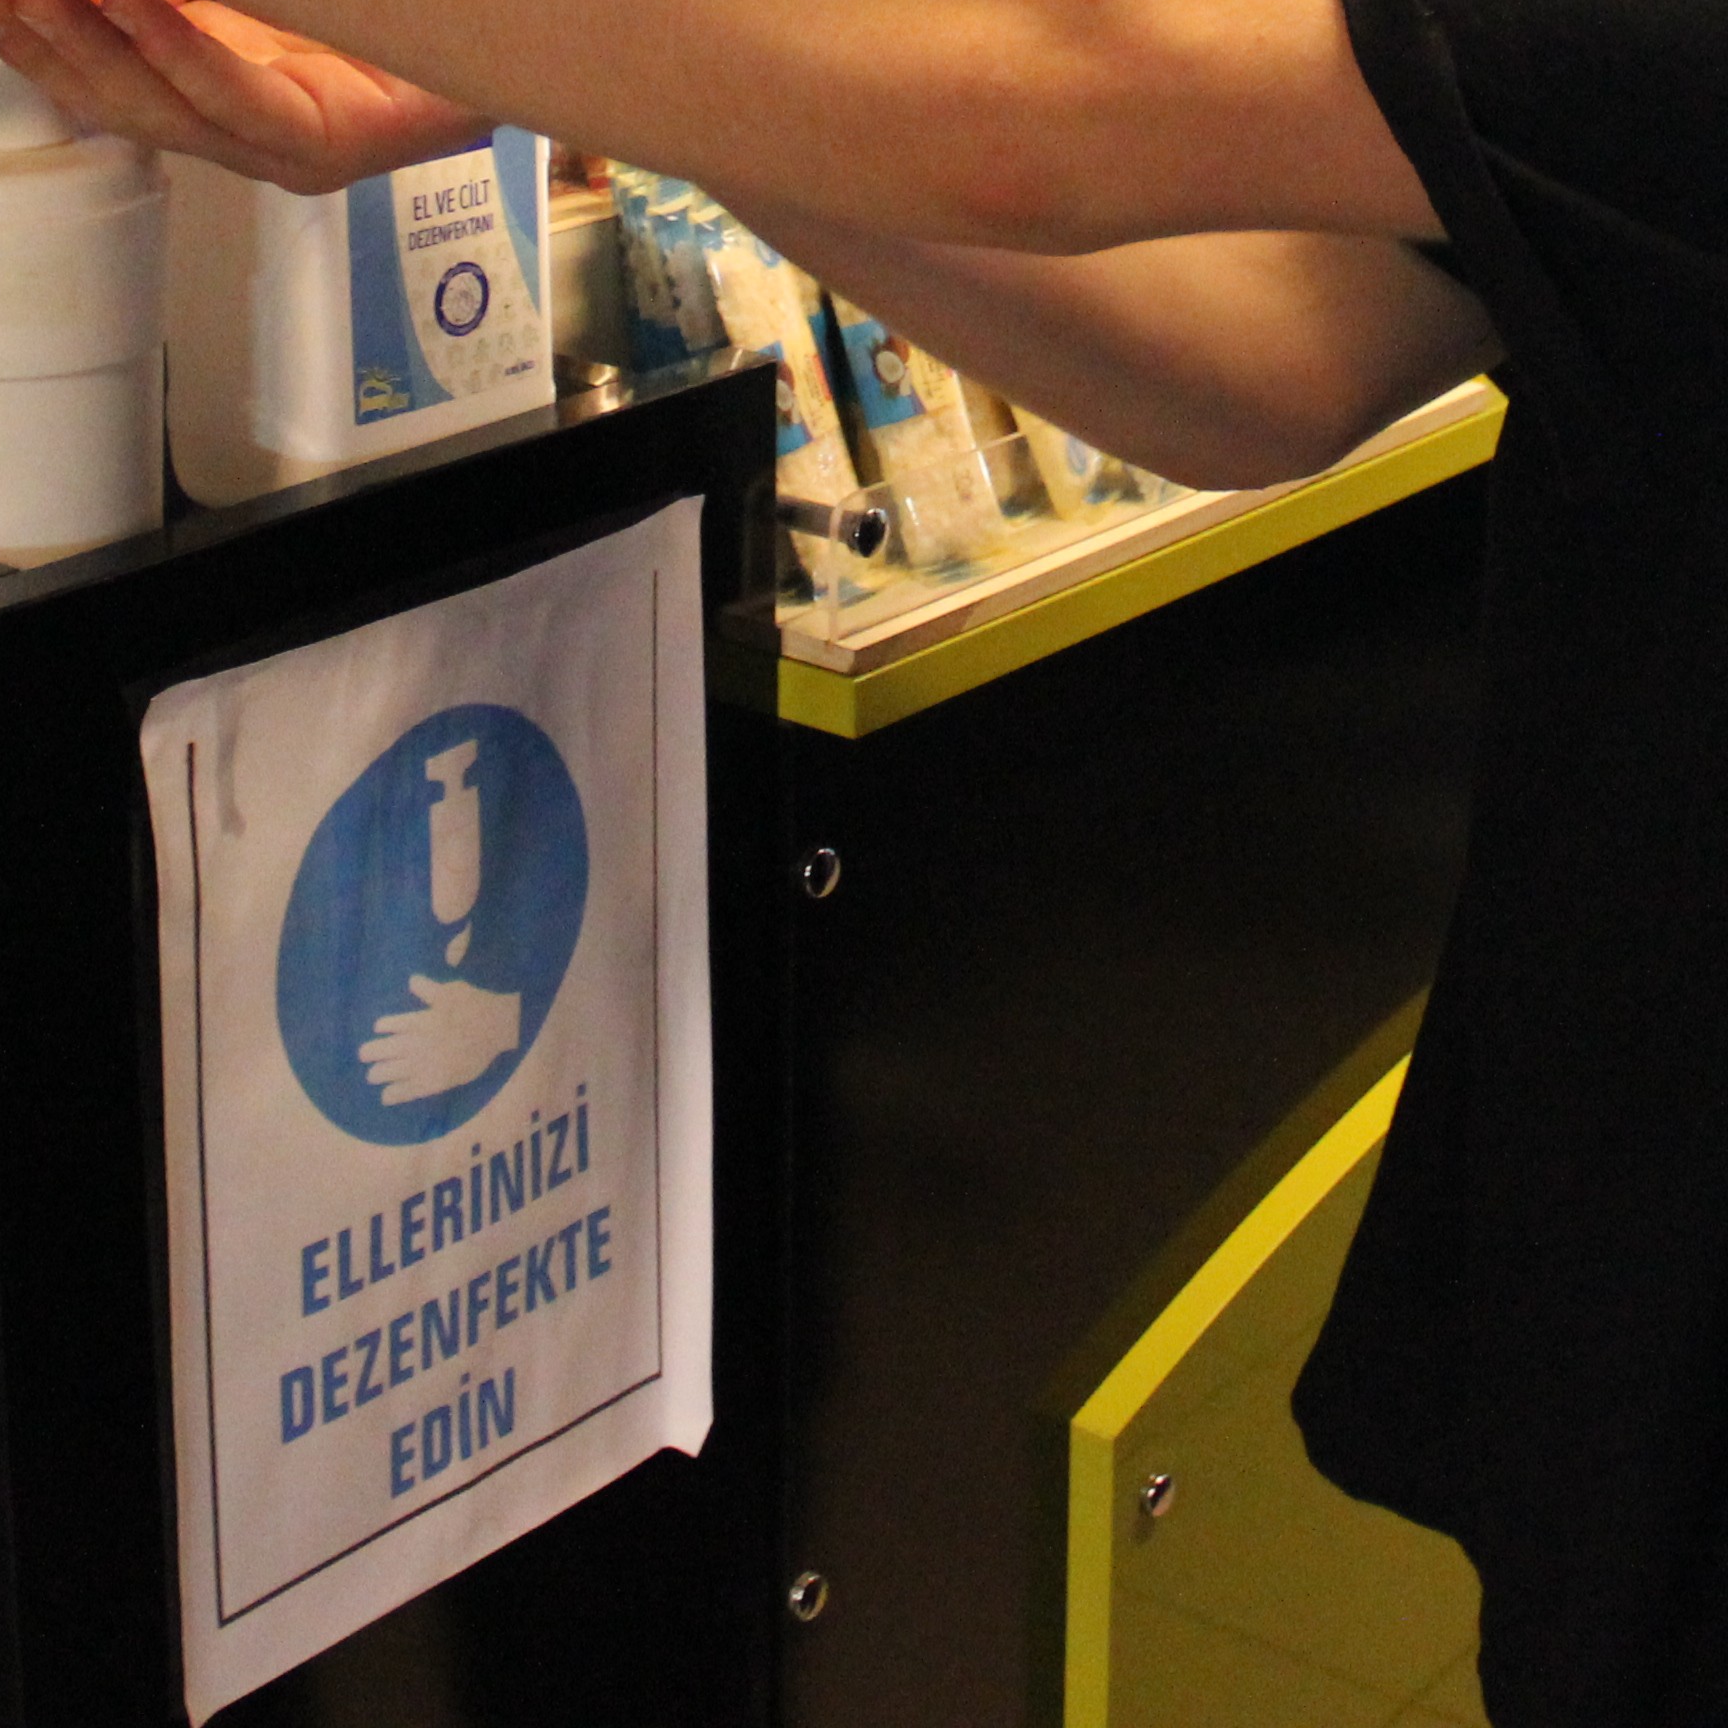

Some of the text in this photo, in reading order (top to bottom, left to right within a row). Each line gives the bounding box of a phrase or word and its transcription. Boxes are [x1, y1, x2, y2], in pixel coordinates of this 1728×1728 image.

[413, 179, 490, 221] EL VE CİLT
[301, 1082, 590, 1317] ELLERİNİZİ
[280, 1204, 613, 1445] DEZENFEKTE
[390, 1367, 516, 1499] EDİN
